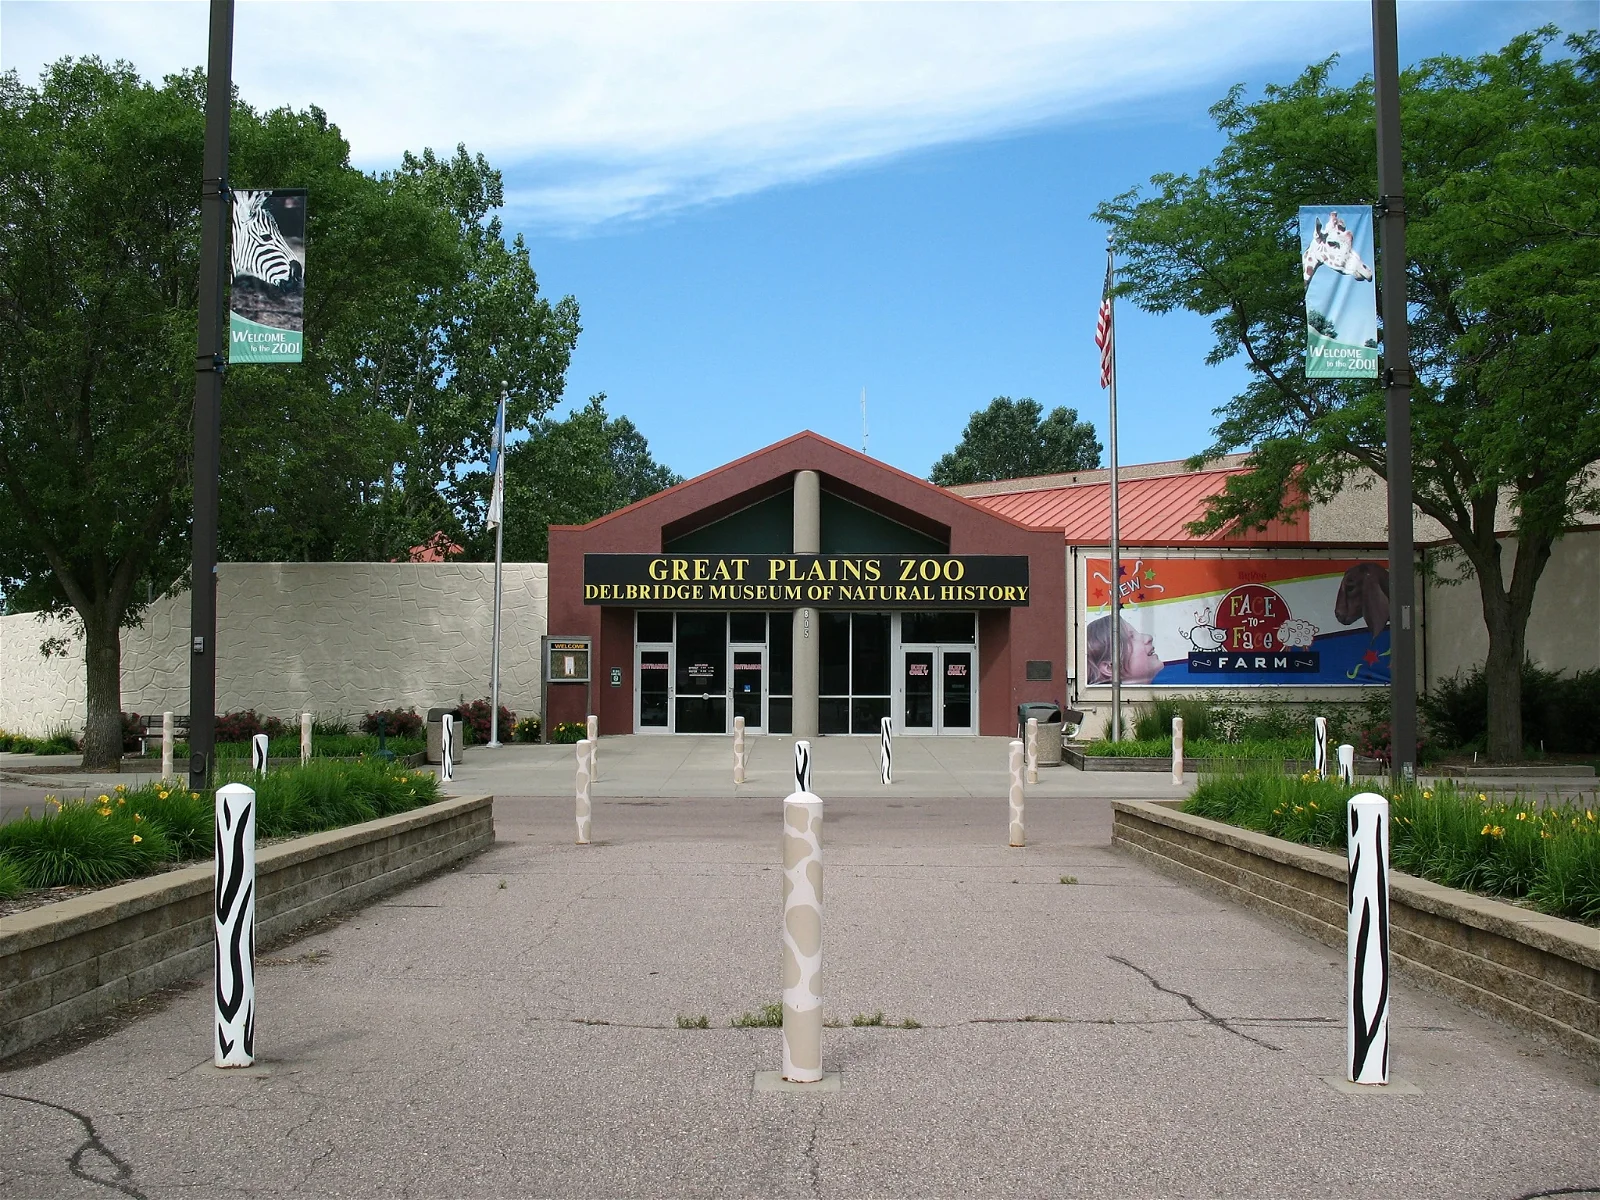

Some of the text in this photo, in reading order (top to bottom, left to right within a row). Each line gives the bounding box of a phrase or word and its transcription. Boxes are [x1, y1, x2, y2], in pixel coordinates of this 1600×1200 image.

[250, 344, 258, 352] to
[260, 344, 270, 352] the
[1348, 358, 1376, 370] ZOO!
[649, 558, 965, 581] GREAT PLAINS ZOO
[584, 584, 1029, 601] DELBRIDGE MUSEUM OF NATURAL HISTORY
[1230, 594, 1277, 617] FACE
[1218, 657, 1287, 668] FARM
